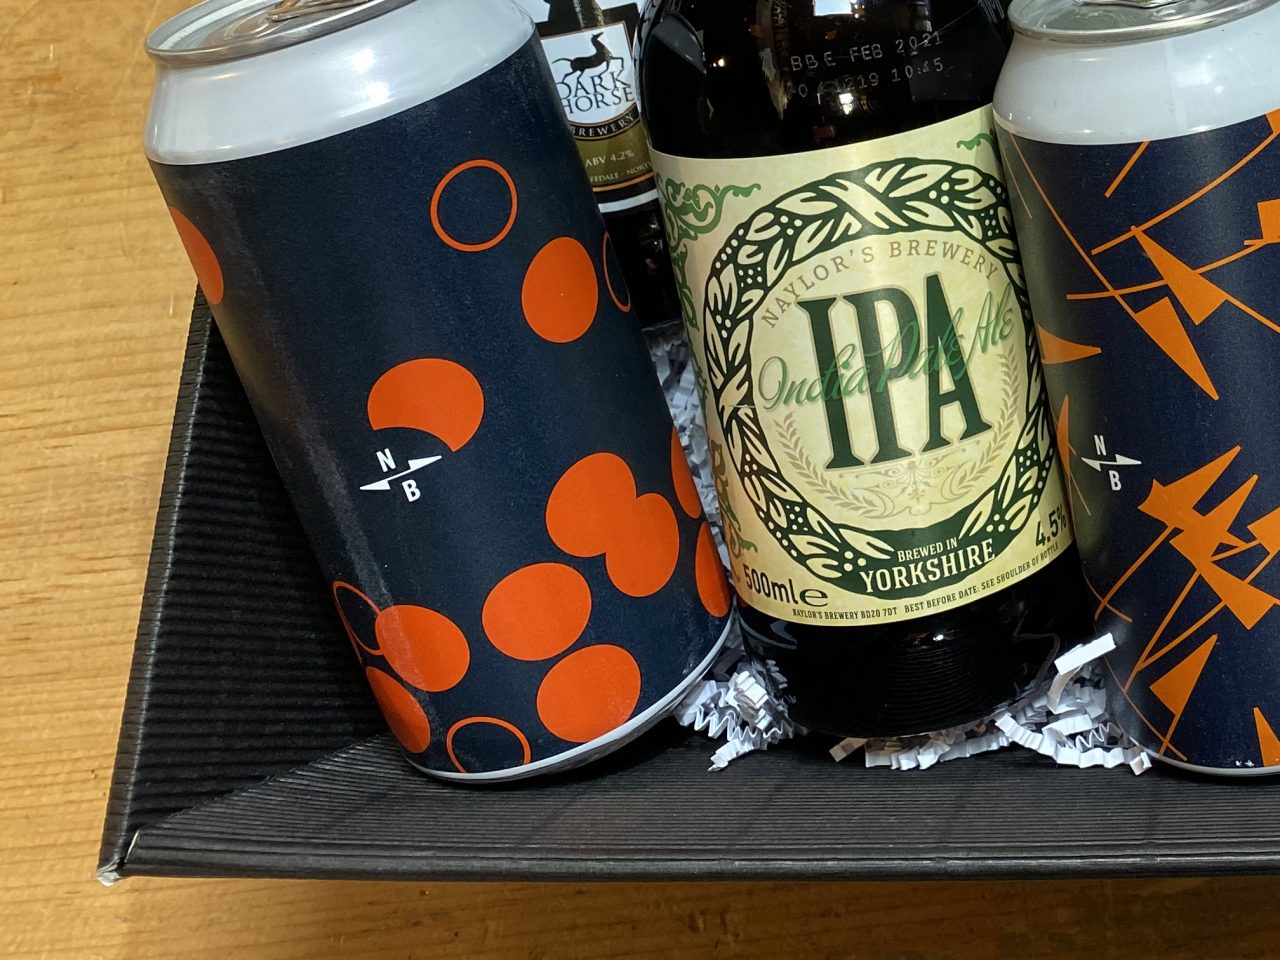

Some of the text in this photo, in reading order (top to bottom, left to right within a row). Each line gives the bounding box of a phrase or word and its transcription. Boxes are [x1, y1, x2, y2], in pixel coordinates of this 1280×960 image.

[790, 31, 943, 72] BBE FEB 2021
[556, 67, 632, 101] DARK
[563, 86, 636, 115] HORSE
[570, 114, 635, 137] BREWERY
[585, 154, 607, 169] ABV
[761, 239, 1000, 329] NAYLOR'S BREWERY
[797, 273, 994, 470] IPA
[1094, 434, 1107, 456] N
[376, 448, 396, 472] N
[401, 479, 421, 502] B
[1108, 470, 1122, 491] B
[1035, 503, 1067, 547] 4.5%
[897, 536, 959, 563] BREWED IN
[859, 538, 997, 594] YORKSHIRE
[792, 542, 1059, 620] NAYLOR'S BREWERY BD20 7DT BEST BEFORE DATE: SEE SHOULDER OF BOTTLE
